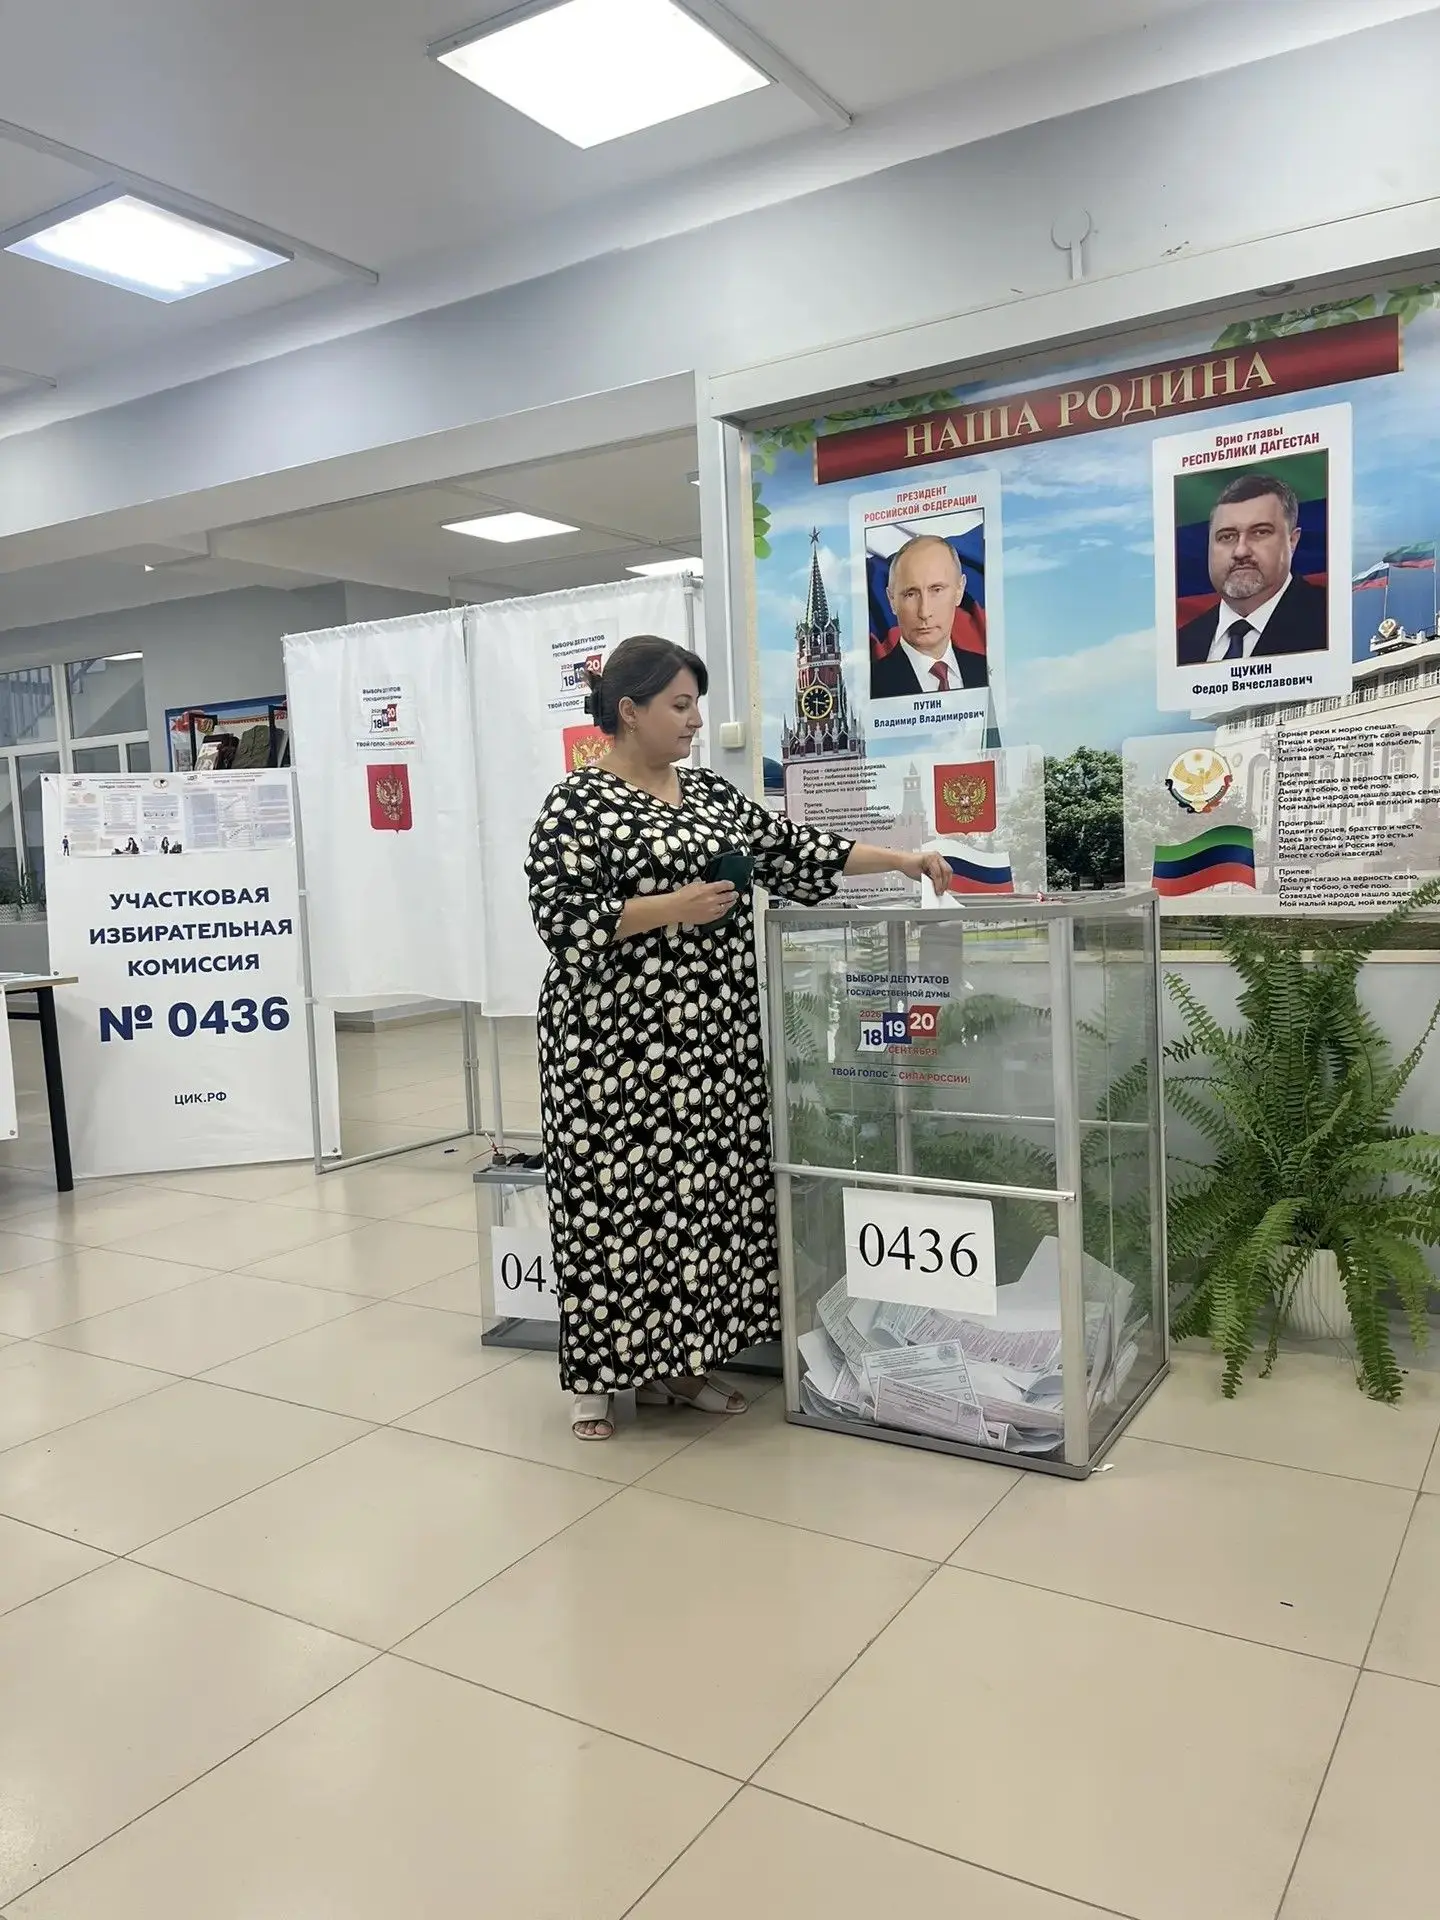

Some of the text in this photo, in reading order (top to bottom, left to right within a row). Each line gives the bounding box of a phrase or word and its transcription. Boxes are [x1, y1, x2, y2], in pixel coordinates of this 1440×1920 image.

[904, 352, 1276, 458] НАША РОДИНА
[1216, 427, 1283, 448] Врио главы
[1182, 433, 1320, 466] РЕСПУБЛИКИ ДАГЕСТАН
[897, 486, 946, 502] ПРЕЗИДЕНТ
[864, 495, 977, 522] РОССИЙСКОЙ ФЕДЕРАЦИИ
[575, 634, 604, 646] ДЕПУТАТОВ
[564, 676, 574, 686] 18
[586, 660, 600, 671] 20
[1230, 664, 1272, 678] ЩУКИН
[1192, 676, 1312, 694] Федор Вячеславович
[914, 700, 942, 710] ПУТИН
[374, 720, 382, 728] 18
[874, 710, 984, 728] Владимир Владимирович
[1314, 736, 1356, 744] вершинам
[1298, 778, 1338, 786] присягаю
[109, 887, 270, 910] УЧАСТКОВАЯ
[90, 919, 292, 944] ИЗБИРАТЕЛЬНАЯ
[128, 954, 260, 976] КОМИССИЯ
[846, 974, 950, 984] ВЫБОРЫ ДЕПУТАТОВ
[846, 988, 950, 998] ГОСУДАРСТВЕННОЙ ДУМЫ
[100, 996, 290, 1042] № 0436
[859, 1010, 880, 1018] 2026
[862, 1013, 934, 1046] 18 19 20
[888, 1046, 938, 1056] СЕНТЯБРЯ
[832, 1067, 970, 1084] ТВОЙ ГОЛОС СИЛА РОССИИ!
[174, 1092, 226, 1106] ЦИК.РФ
[860, 1222, 978, 1277] 0436
